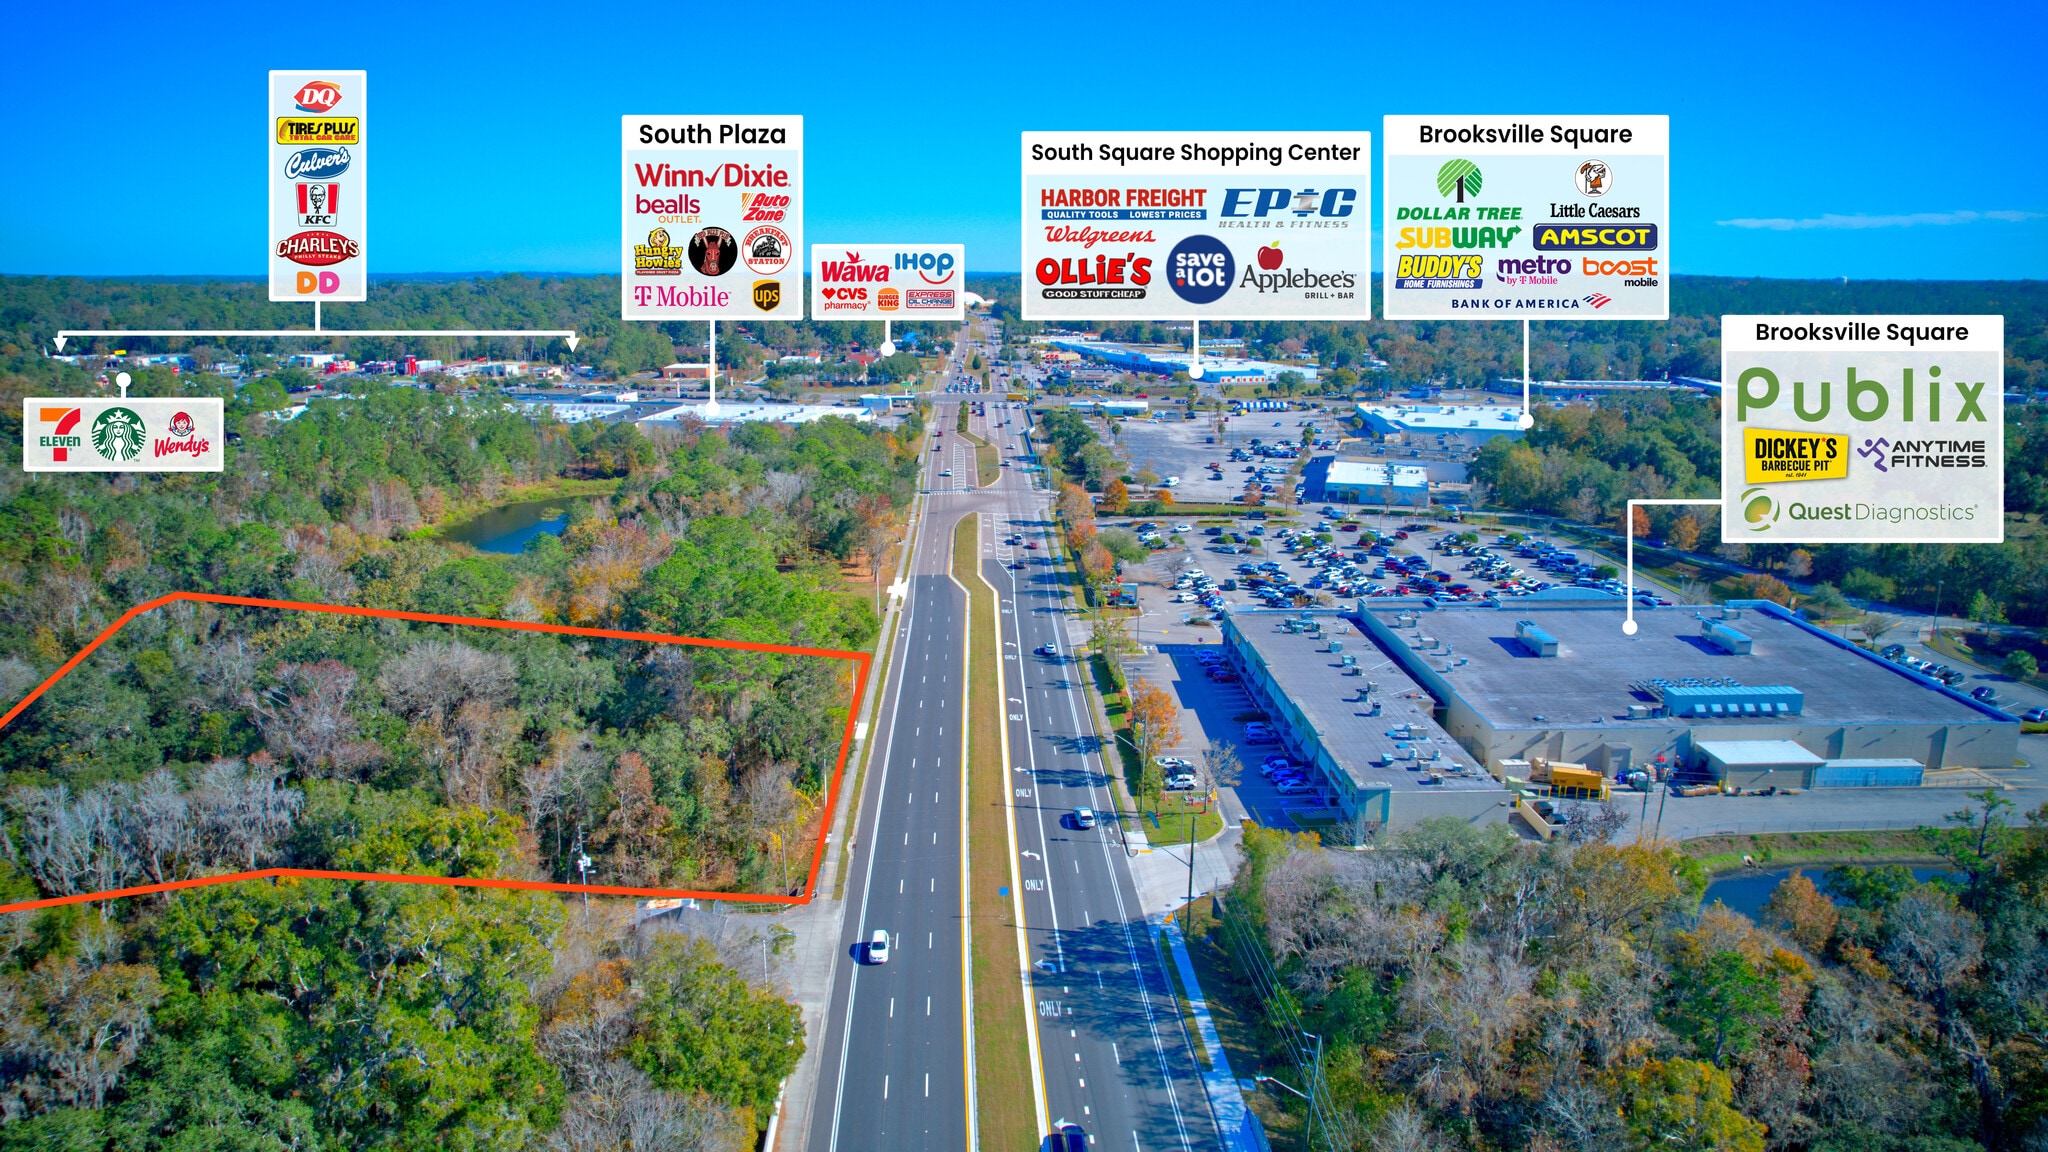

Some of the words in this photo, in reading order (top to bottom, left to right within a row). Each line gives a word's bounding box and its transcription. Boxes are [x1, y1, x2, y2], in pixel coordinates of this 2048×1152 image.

[1015, 789, 1031, 797] ONLY
[1025, 880, 1043, 890] ONLY
[1039, 1001, 1062, 1016] ONLY
